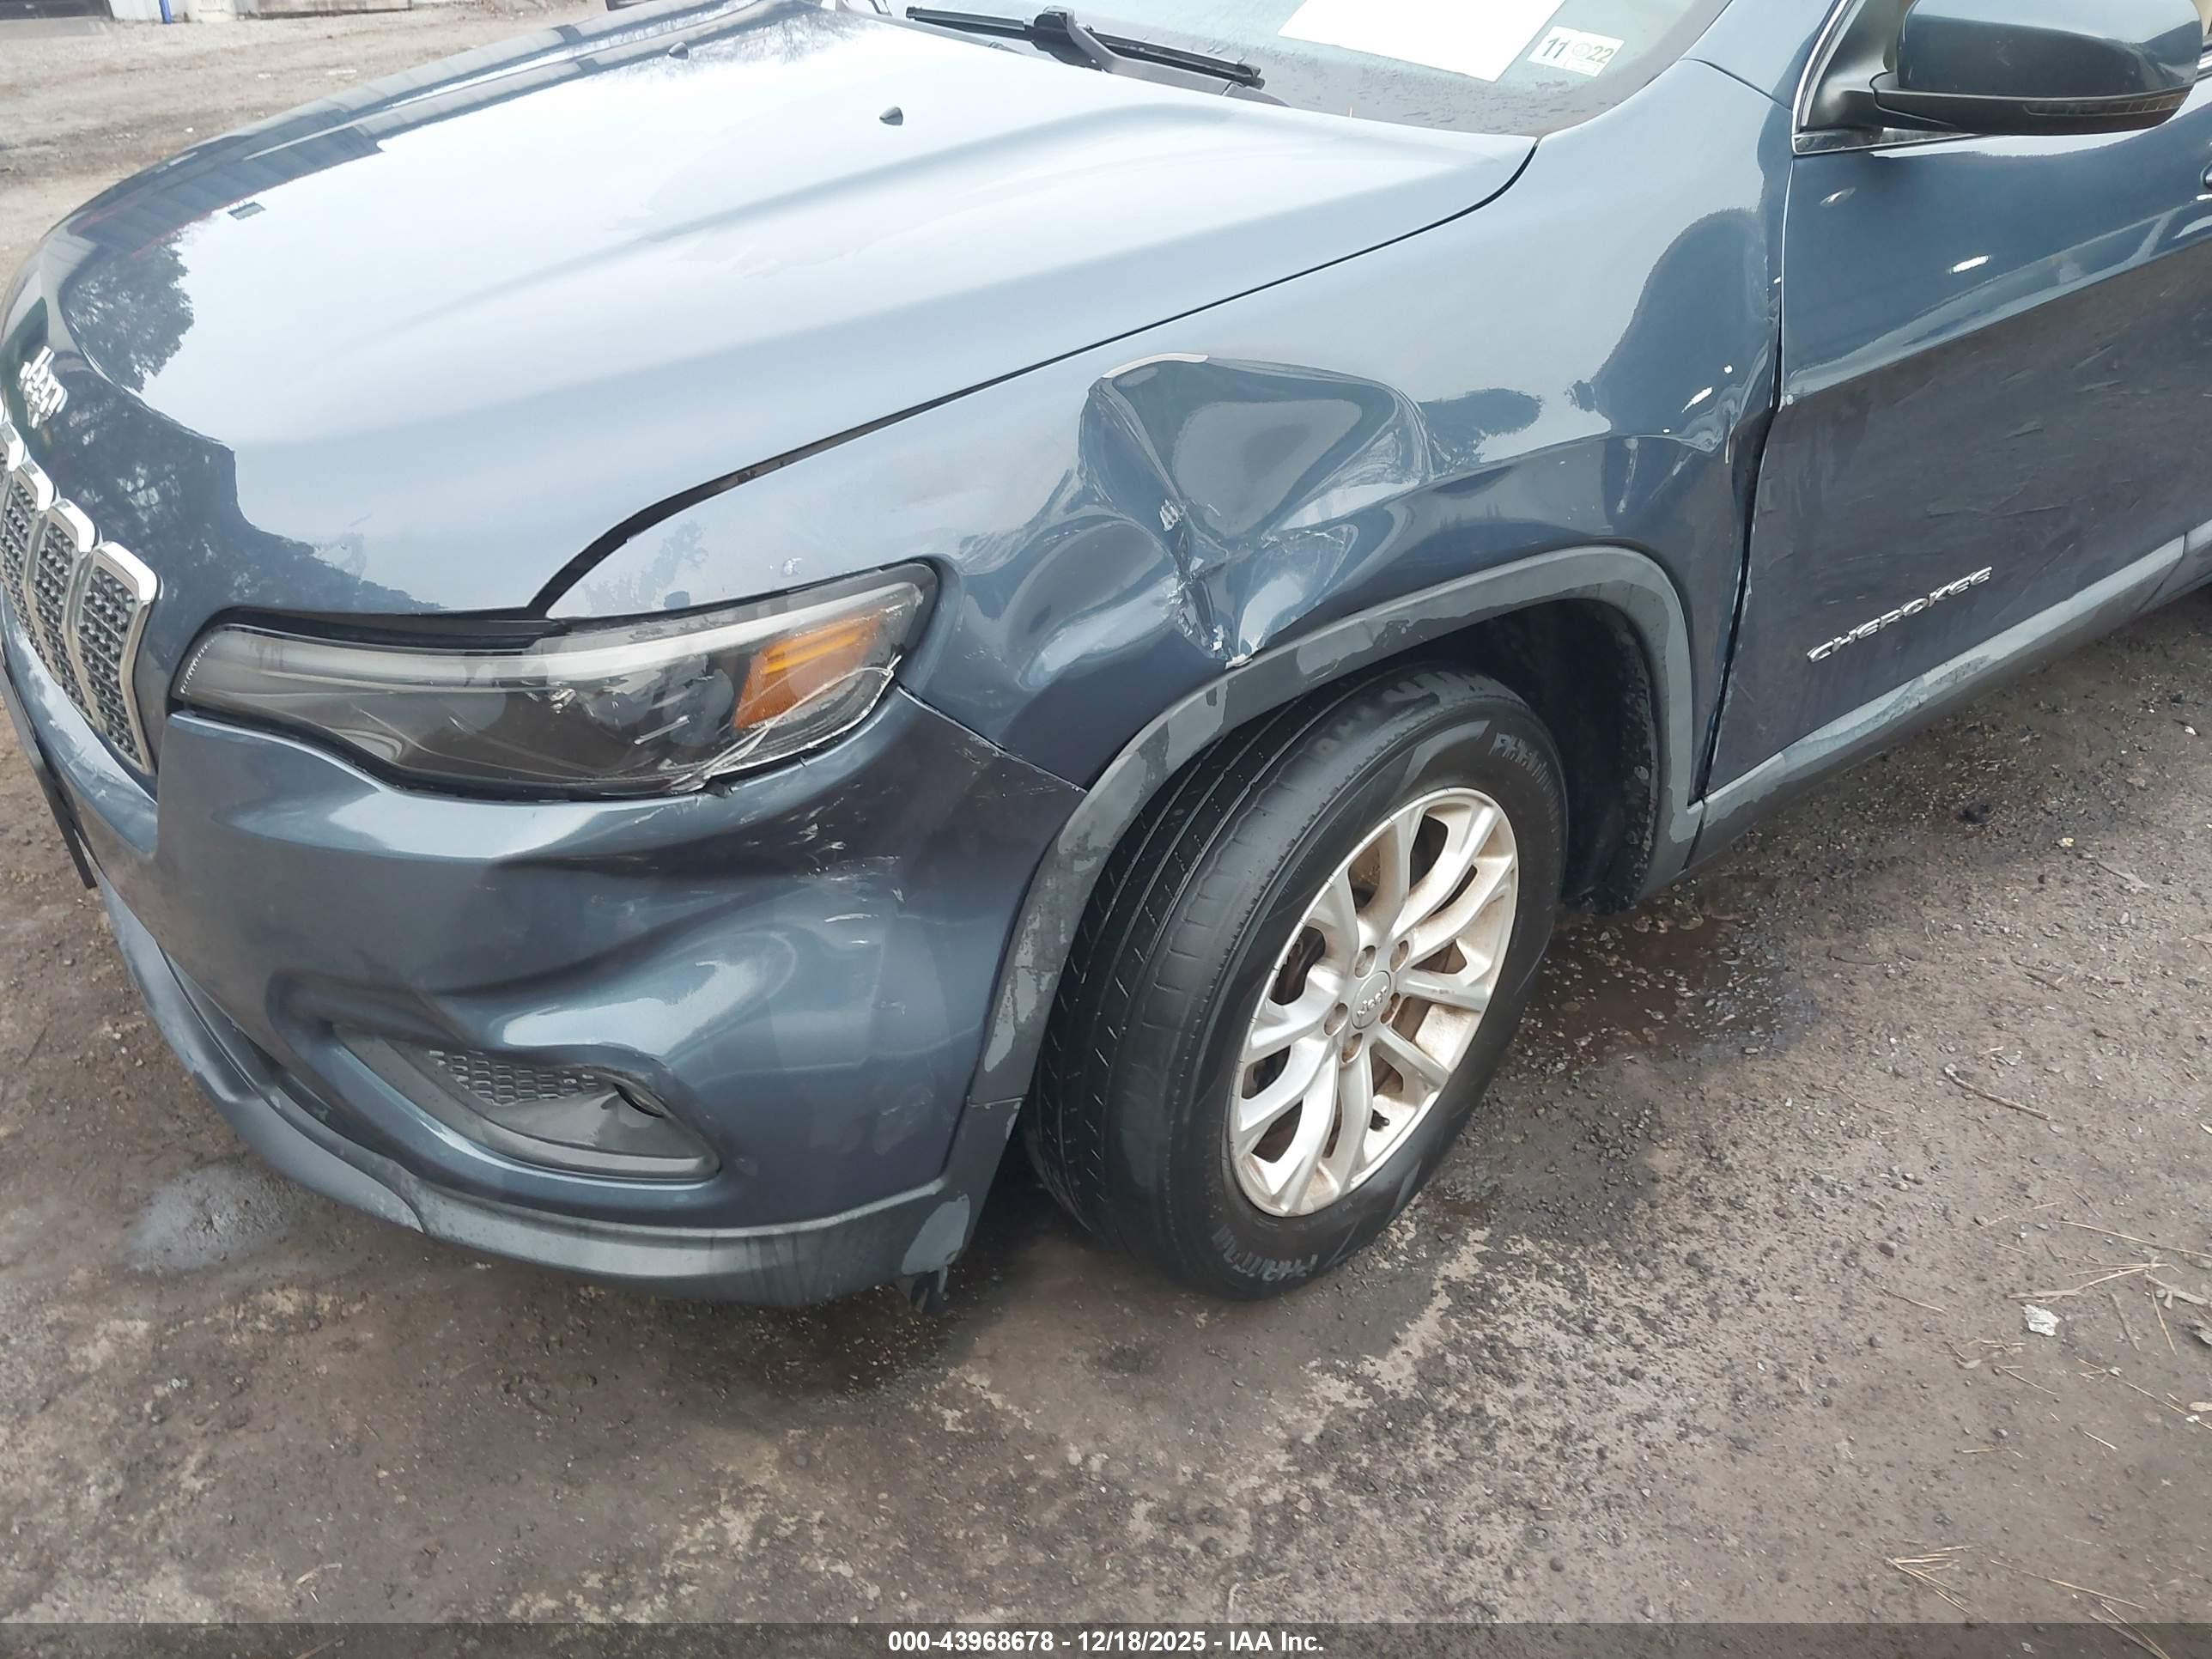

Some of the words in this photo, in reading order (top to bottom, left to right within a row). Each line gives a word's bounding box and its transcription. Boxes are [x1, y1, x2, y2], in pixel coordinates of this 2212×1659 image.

[1541, 36, 1571, 59] 11
[1585, 45, 1615, 64] 22
[1806, 565, 1993, 663] CHEROKEE
